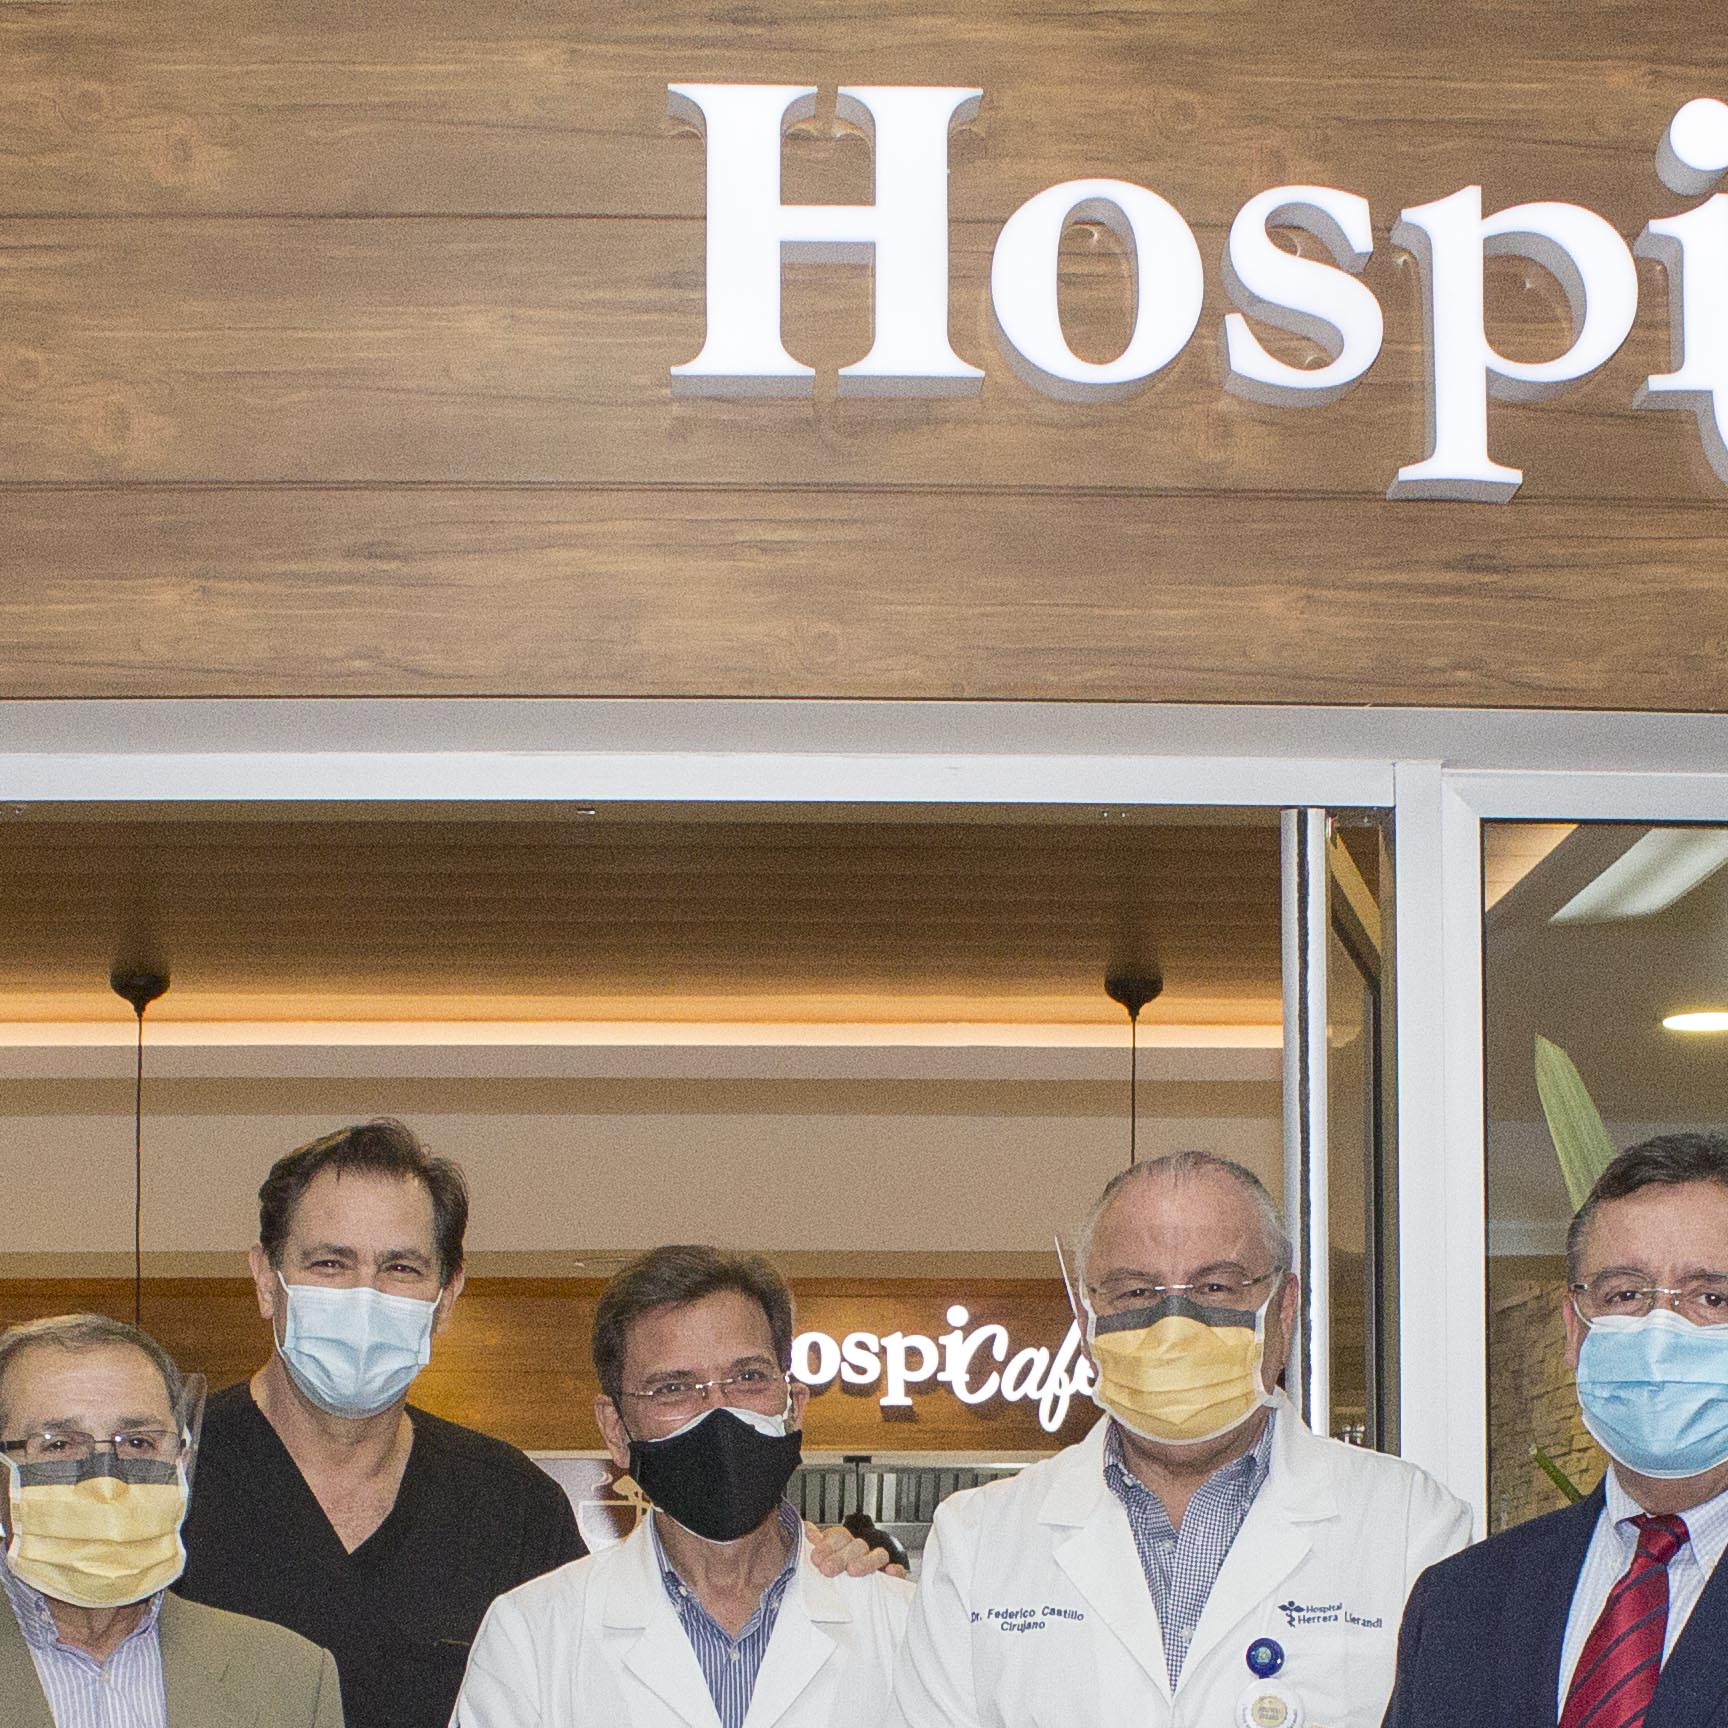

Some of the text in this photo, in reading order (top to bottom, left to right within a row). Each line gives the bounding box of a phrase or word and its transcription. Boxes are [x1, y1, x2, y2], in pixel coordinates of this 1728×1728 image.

[789, 1304, 1099, 1434] ospiCaf
[986, 1607, 1036, 1620] Federico
[1041, 1605, 1085, 1621] Castillo
[1306, 1602, 1343, 1614] Hospital
[1000, 1620, 1046, 1634] Cirujano
[1297, 1610, 1383, 1629] Herrera Llerandi
